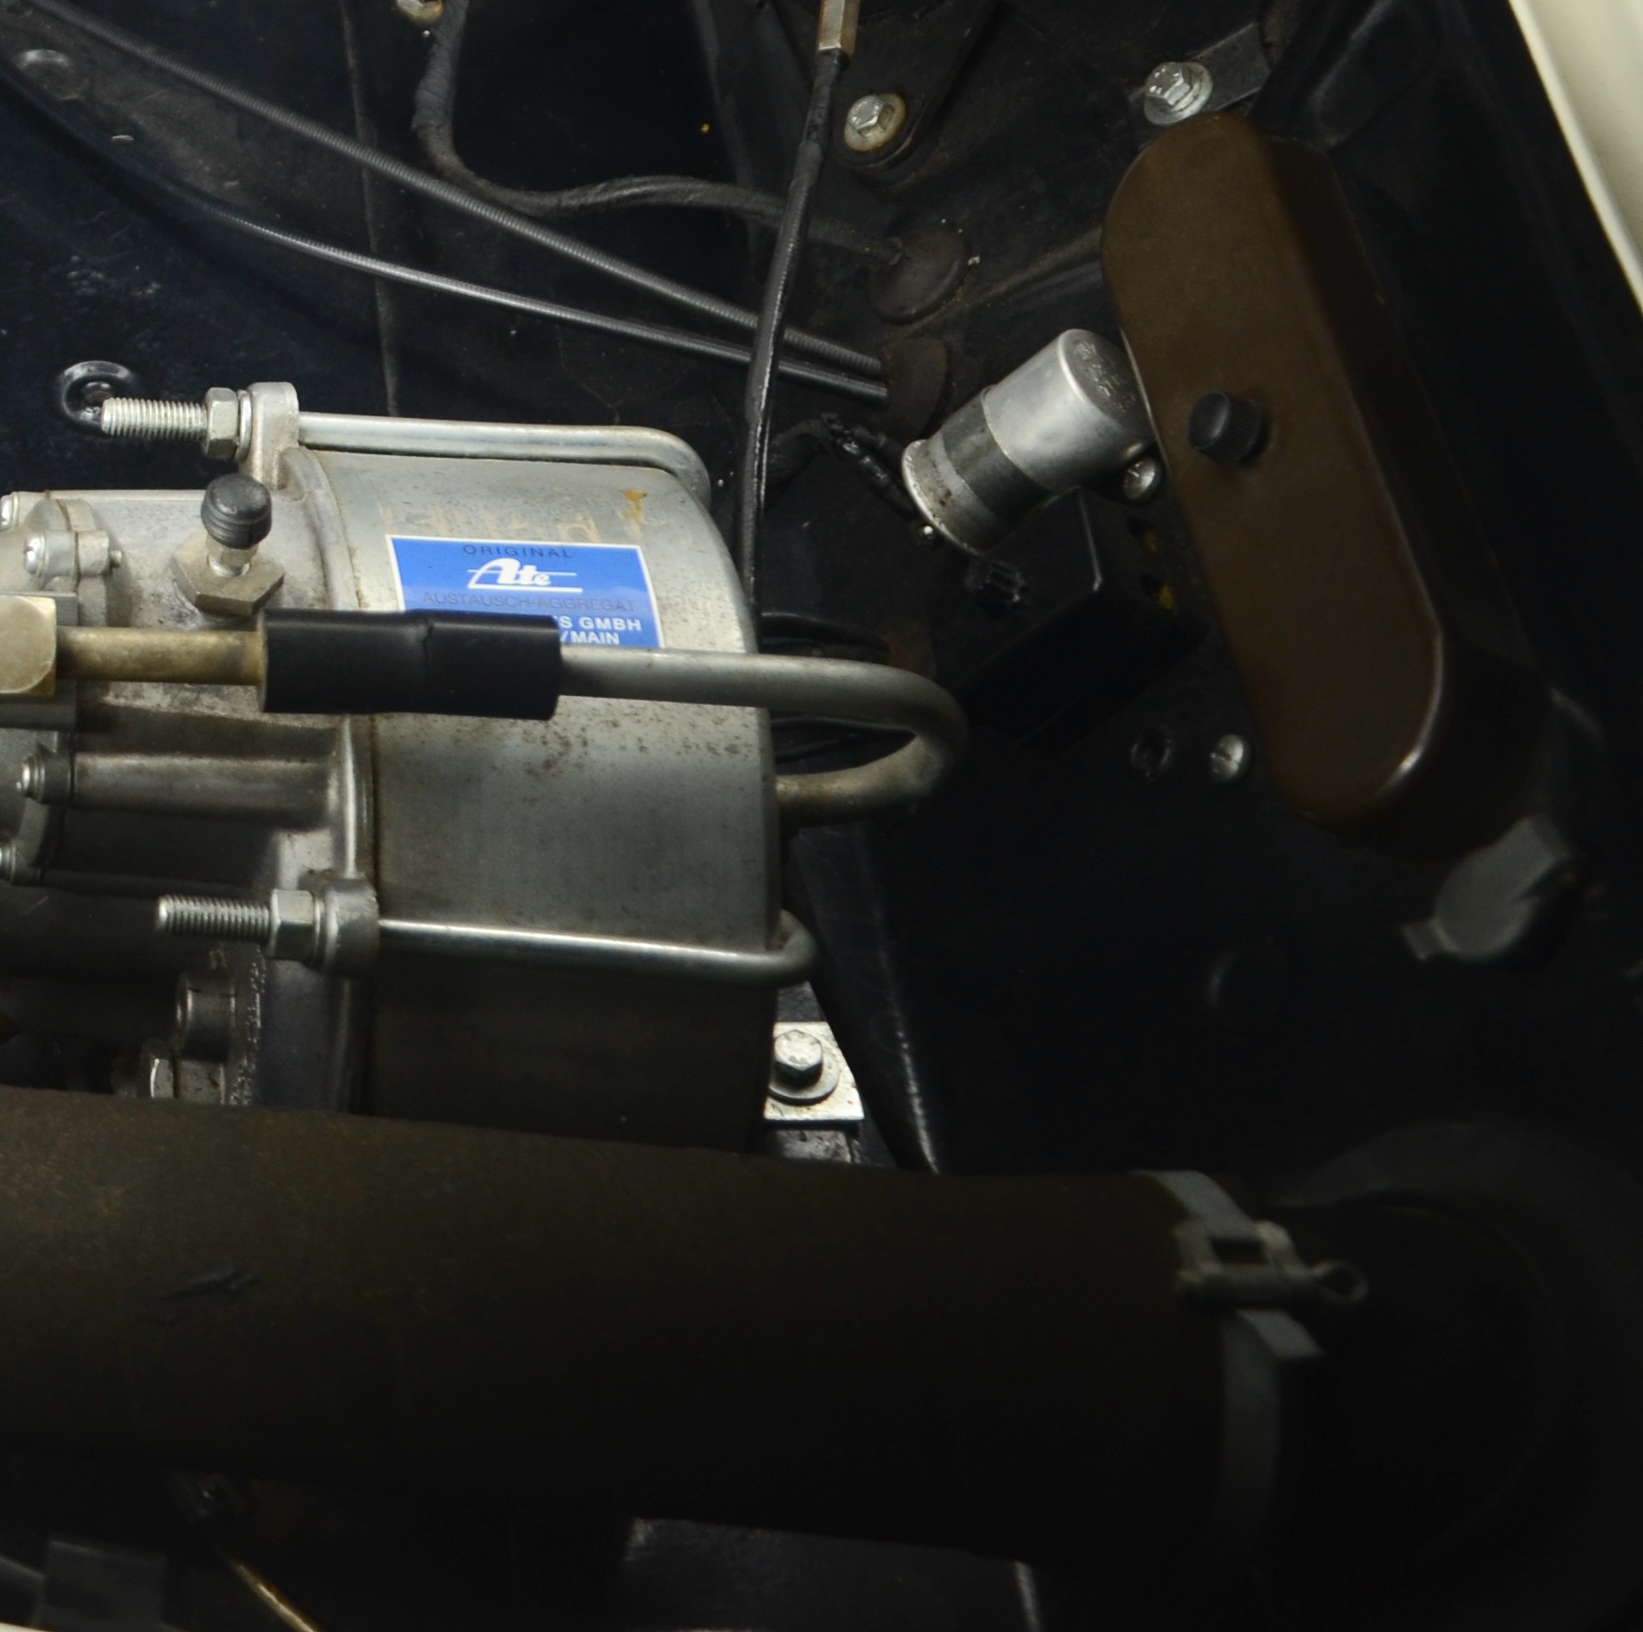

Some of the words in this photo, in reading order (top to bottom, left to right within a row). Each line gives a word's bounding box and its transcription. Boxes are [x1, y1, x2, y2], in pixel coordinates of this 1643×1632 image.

[462, 543, 572, 559] ORIGINAL
[422, 591, 636, 612] AUSTAUSCH-AGGREGAT
[577, 617, 643, 632] GMBH
